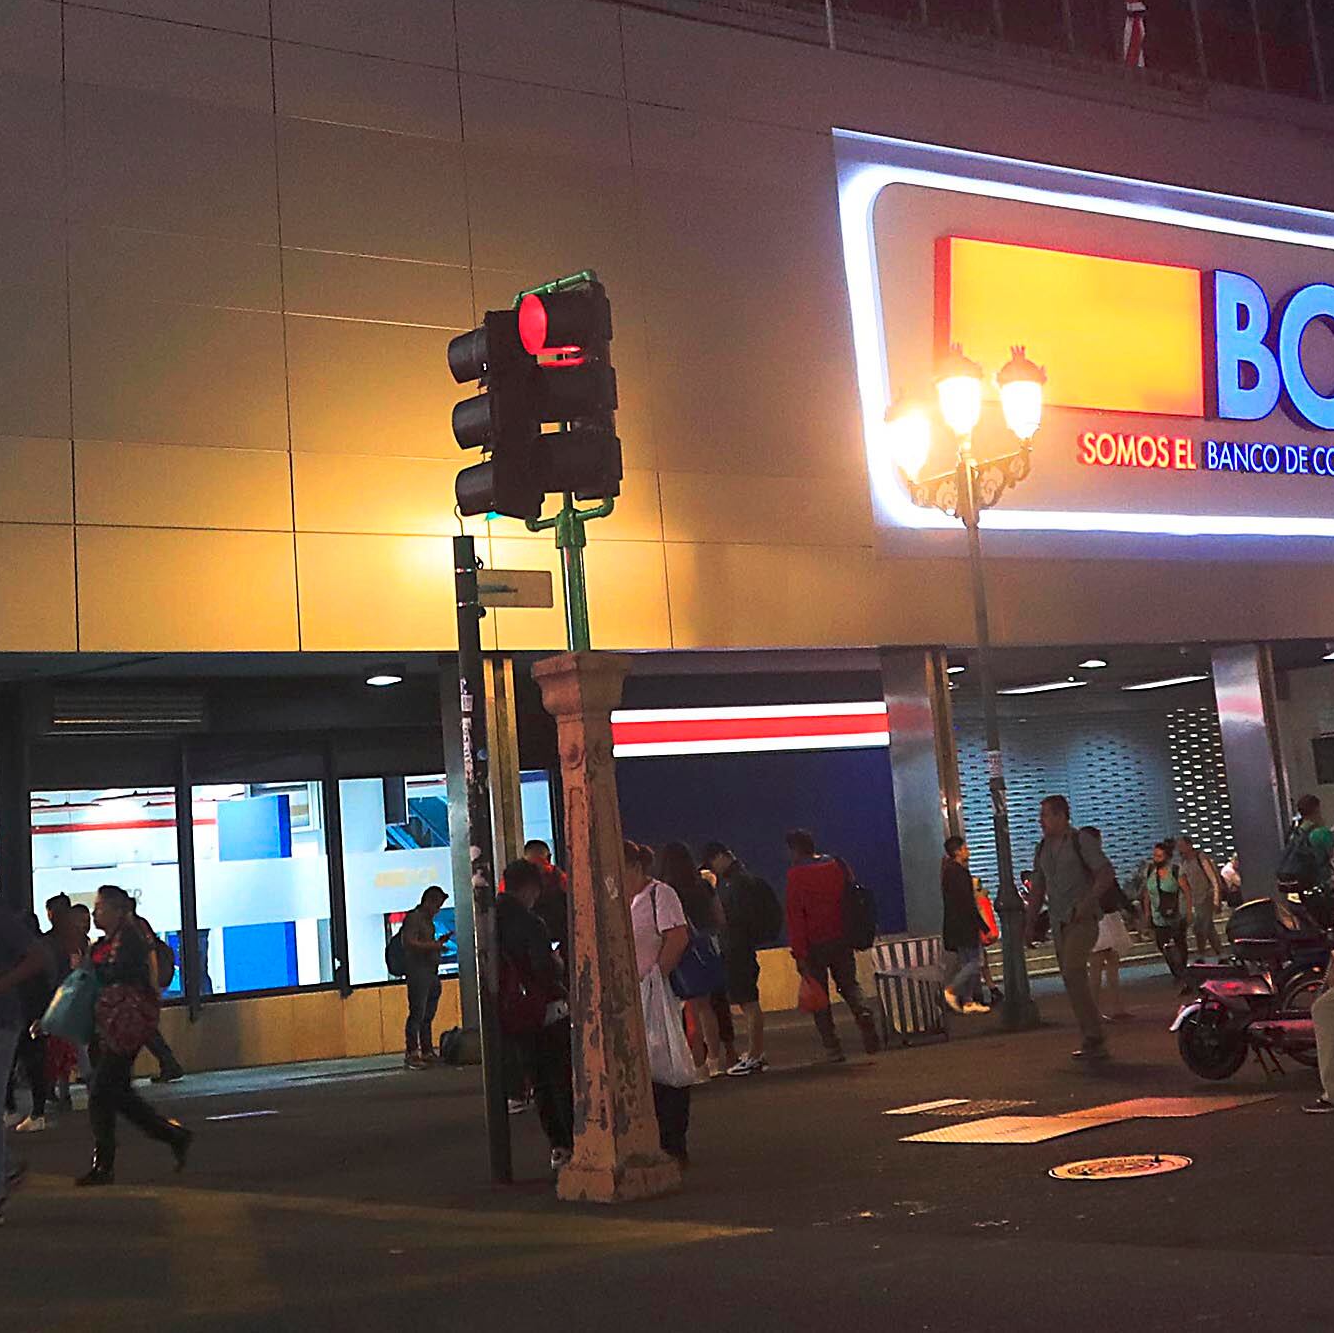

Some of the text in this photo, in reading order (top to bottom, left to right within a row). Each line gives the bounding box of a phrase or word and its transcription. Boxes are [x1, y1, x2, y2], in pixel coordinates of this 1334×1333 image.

[1082, 431, 1169, 468] SOMOS
[1174, 437, 1197, 470] EL
[1206, 441, 1280, 473] BANCO
[1285, 445, 1309, 474] DE
